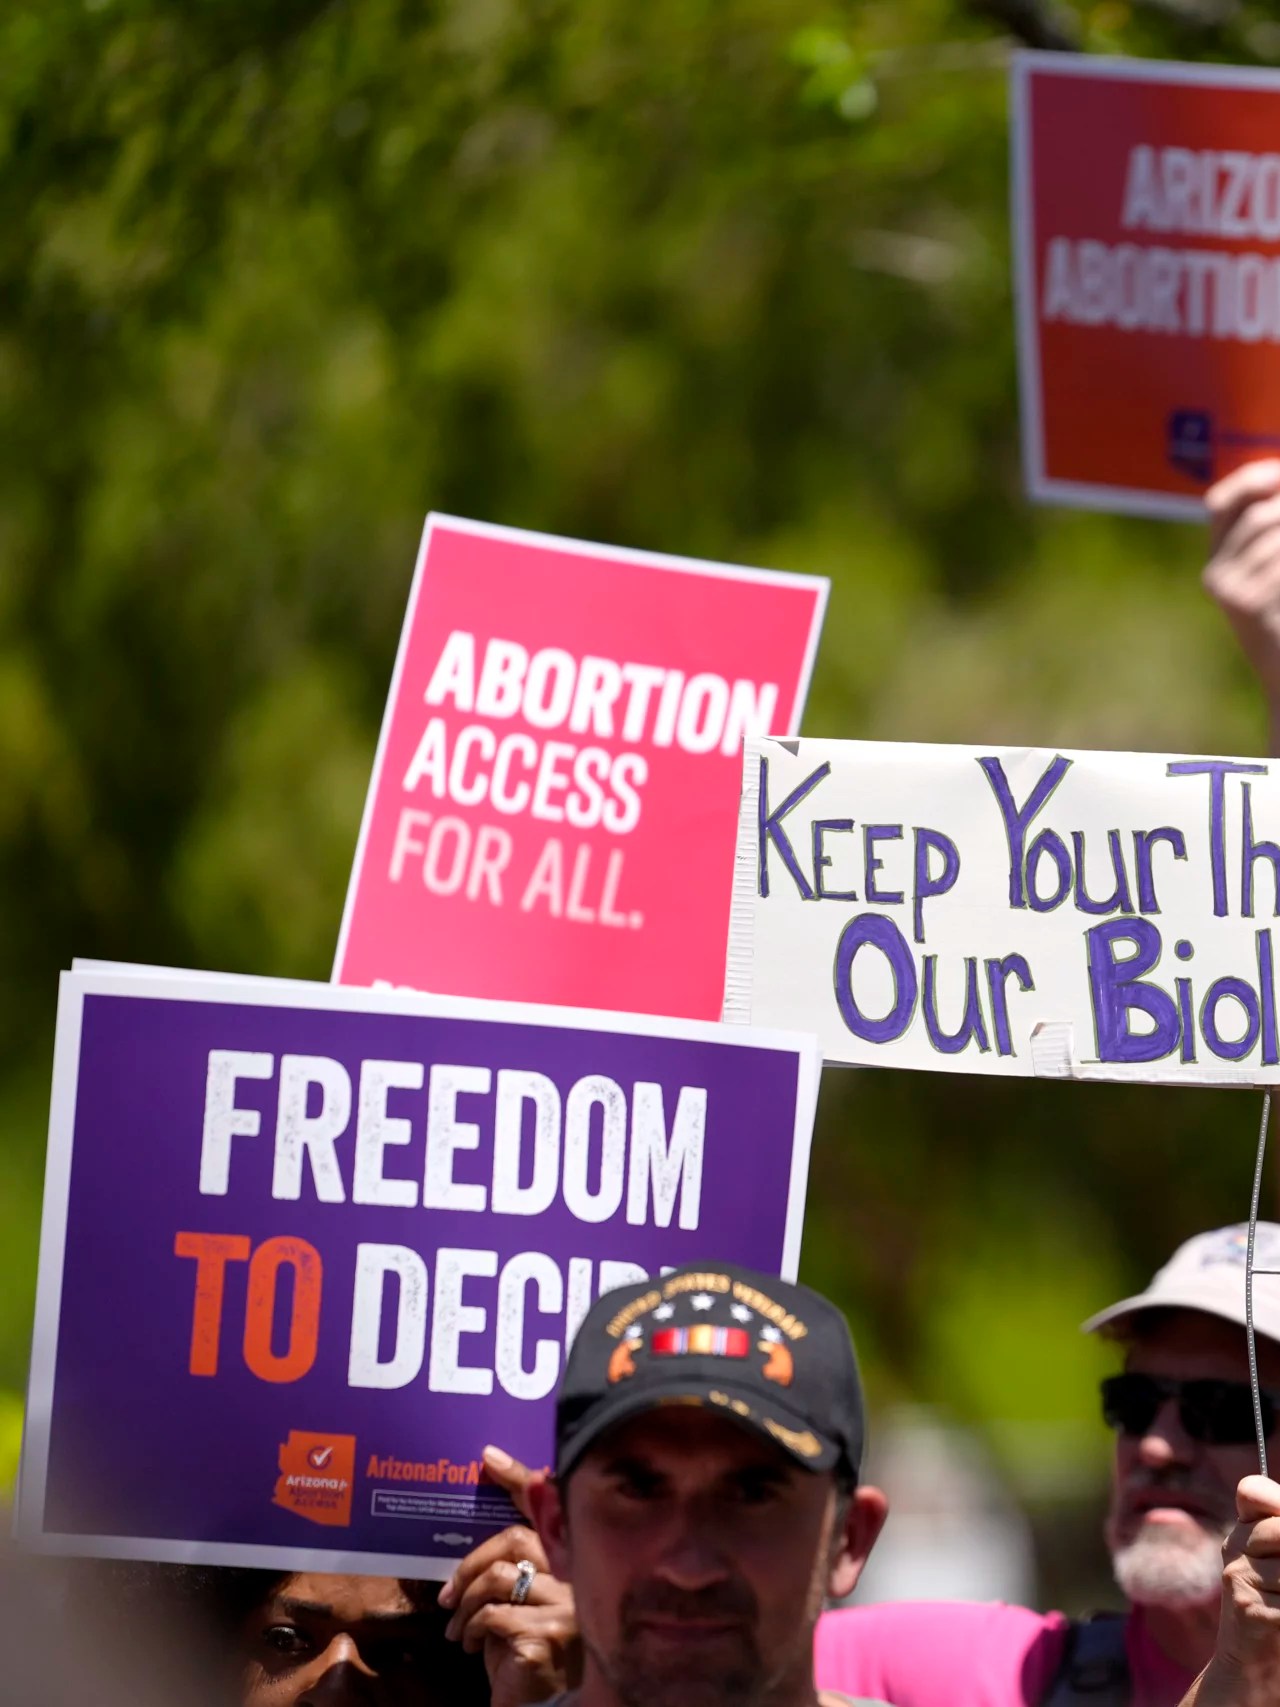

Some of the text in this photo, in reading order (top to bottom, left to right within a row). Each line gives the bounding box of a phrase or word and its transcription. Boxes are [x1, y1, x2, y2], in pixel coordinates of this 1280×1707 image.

[424, 630, 778, 757] ABORTION
[402, 718, 648, 834] ACCESS
[974, 753, 1189, 915] Your
[388, 808, 644, 930] FOR ALL.
[832, 912, 1036, 1058] Our
[199, 1049, 708, 1231] FREEDOM
[174, 1231, 678, 1400] TO DECI
[286, 1475, 337, 1490] Arizona
